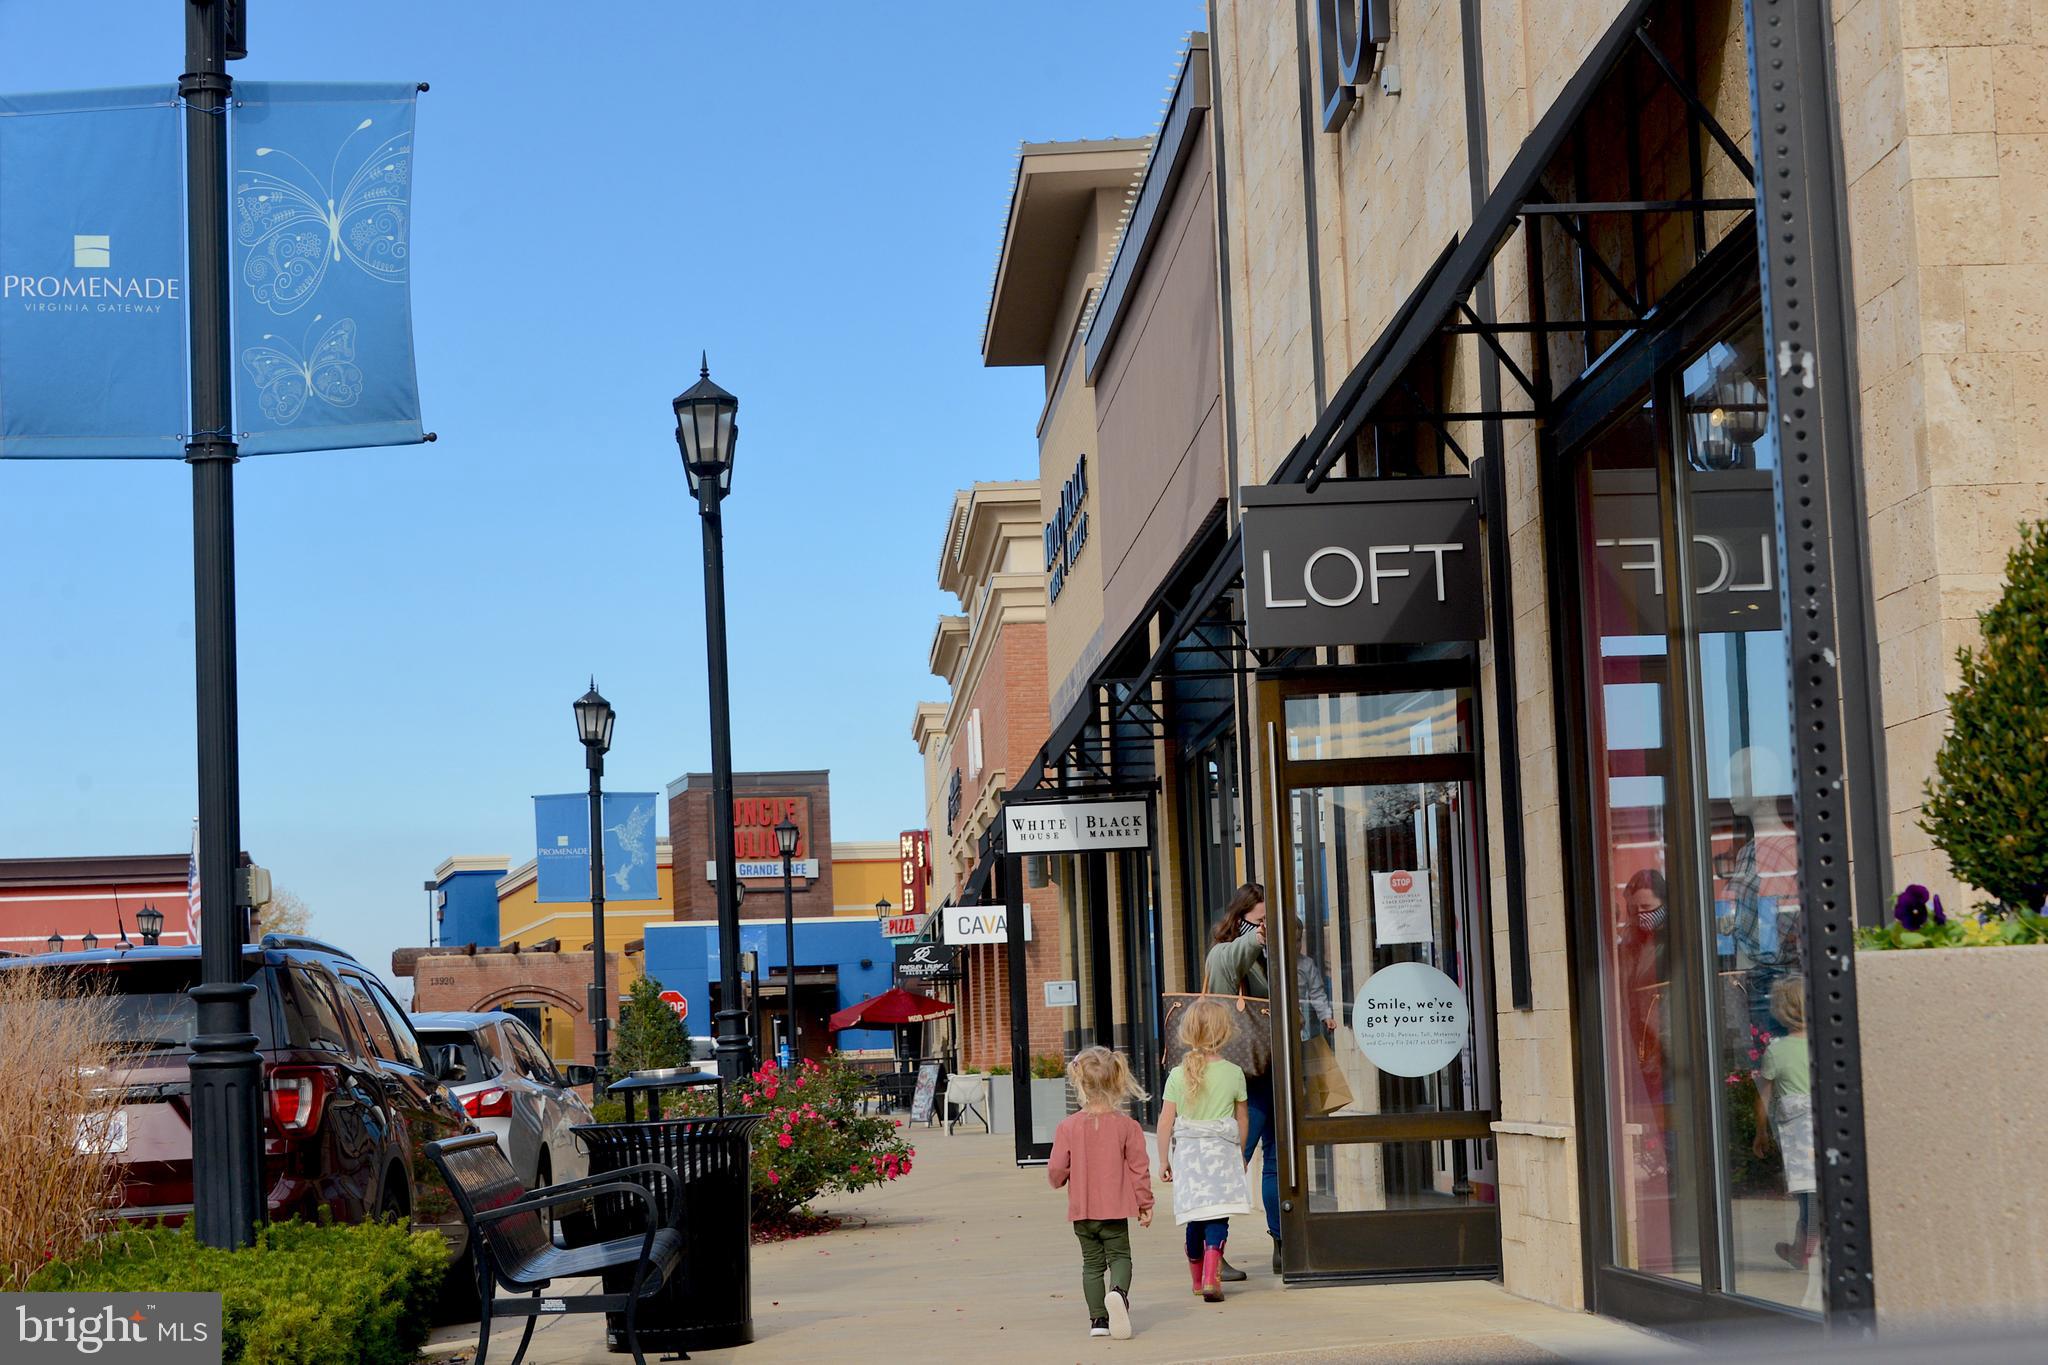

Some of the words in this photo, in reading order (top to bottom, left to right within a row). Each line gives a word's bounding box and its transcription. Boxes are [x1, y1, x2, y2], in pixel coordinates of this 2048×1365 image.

[4, 275, 180, 300] PROMENADE
[24, 303, 90, 313] VIRGINIA
[96, 303, 162, 313] GATEWAY
[1262, 543, 1464, 608] LOFT
[1012, 819, 1067, 831] WHITE
[1086, 815, 1142, 828] BLACK
[1020, 832, 1060, 840] HOUSE
[1089, 828, 1140, 838] MARKET
[538, 848, 588, 856] PROMENADE
[739, 863, 779, 876] GRANDE
[901, 835, 914, 912] MOD
[1391, 878, 1411, 887] STOP
[888, 918, 915, 934] PIZZA
[958, 916, 1008, 935] CAVA
[1367, 998, 1411, 1011] Smile,
[1416, 997, 1453, 1009] we've
[1366, 1015, 1388, 1028] got
[1394, 1015, 1424, 1028] your
[1429, 1011, 1455, 1023] size
